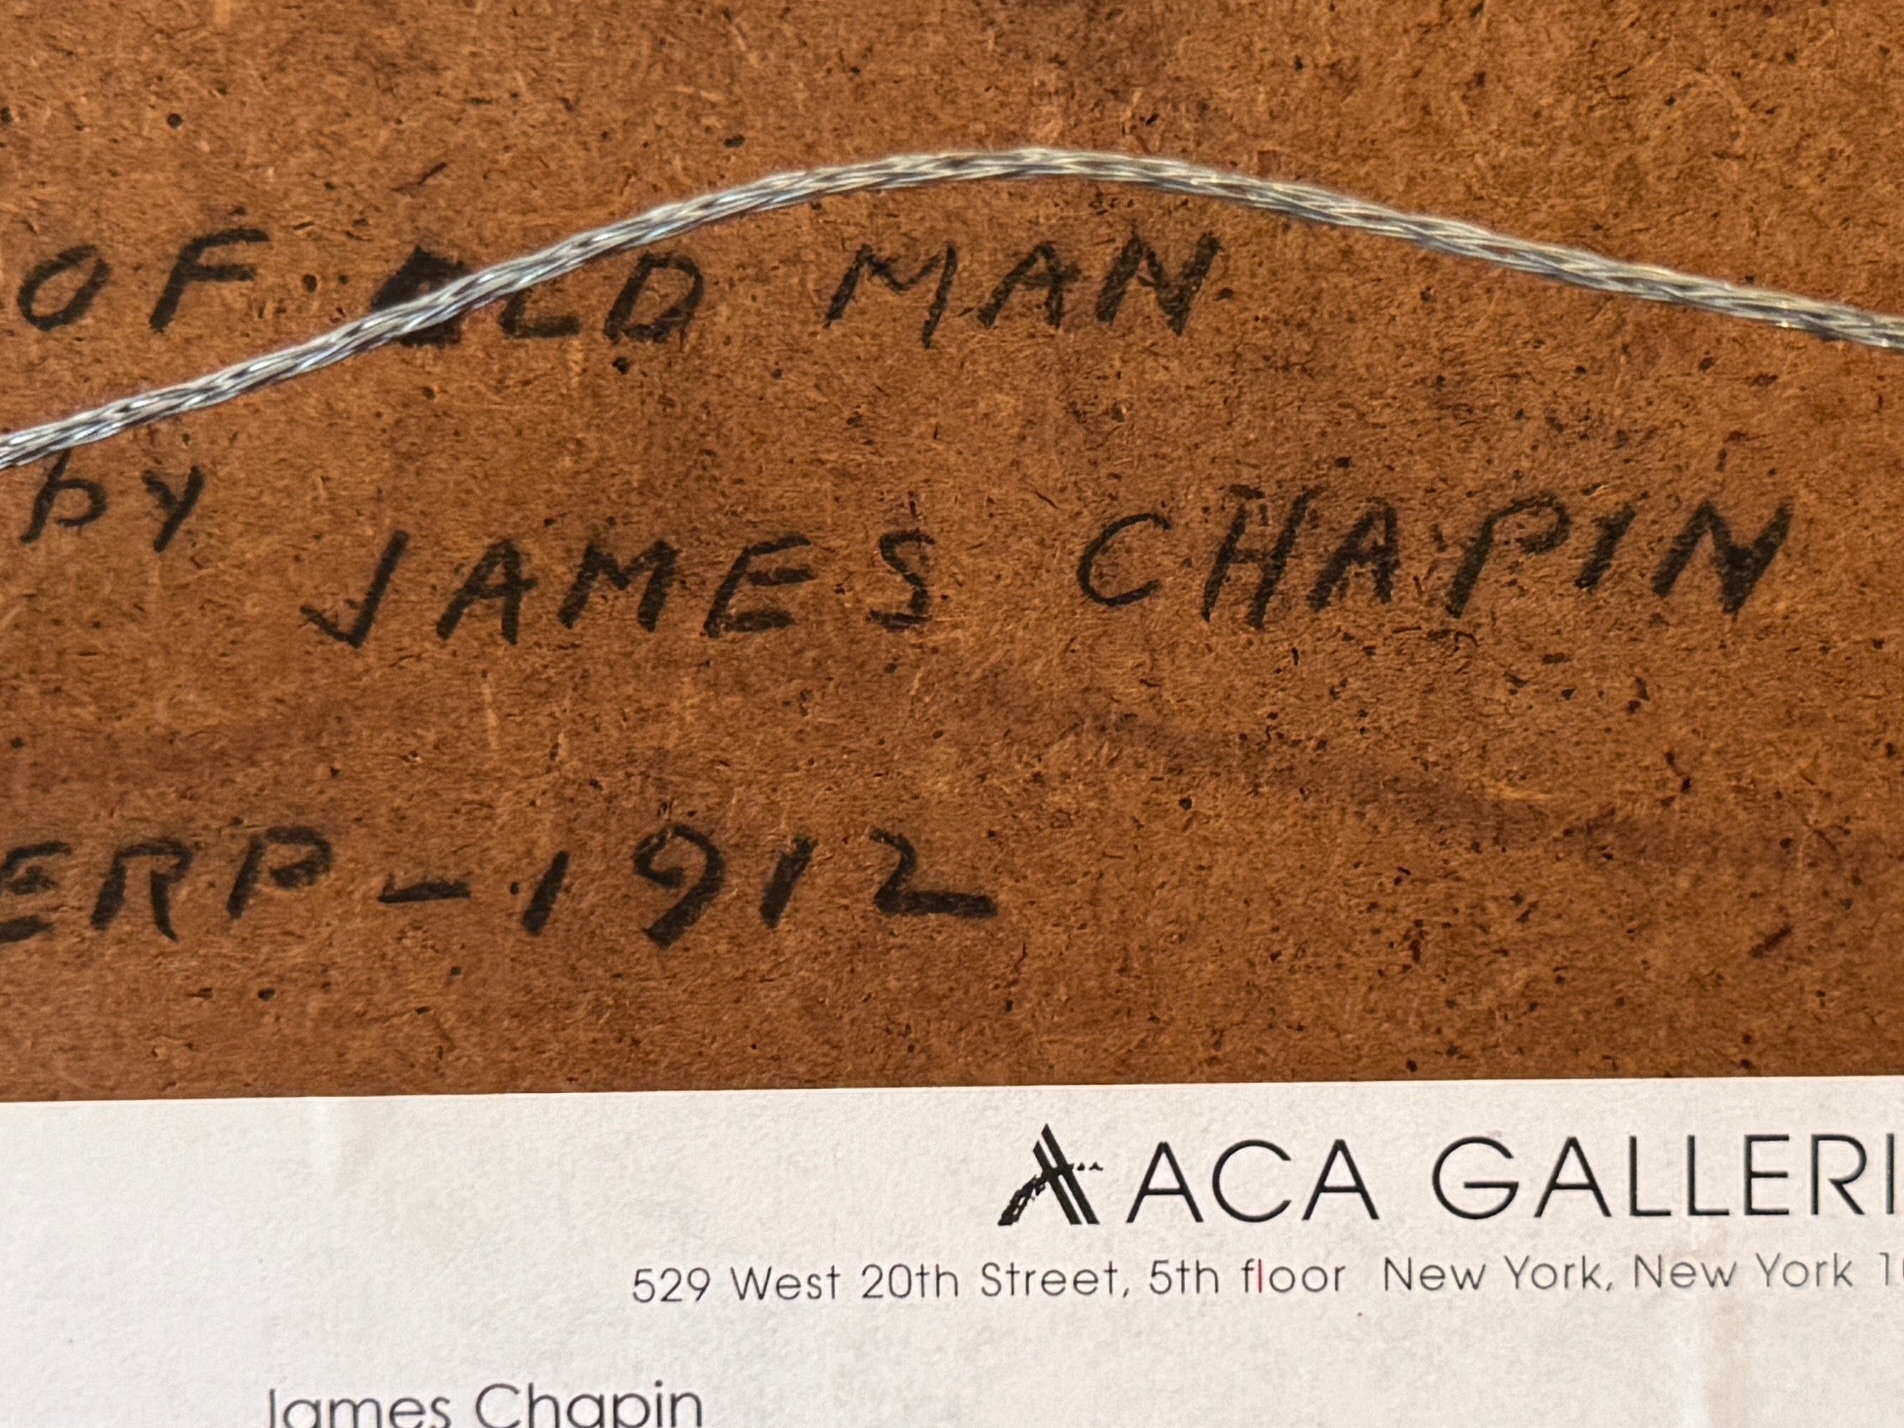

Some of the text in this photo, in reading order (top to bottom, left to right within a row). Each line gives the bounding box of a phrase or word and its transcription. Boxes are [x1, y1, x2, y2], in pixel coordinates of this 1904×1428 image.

[16, 227, 272, 334] OF
[823, 228, 1224, 349] MAN
[301, 529, 938, 650] JAMES
[1076, 484, 1793, 630] CHAPIN
[1124, 1137, 1381, 1225] ACA
[631, 1266, 712, 1305] 529
[729, 1264, 842, 1302] West
[860, 1262, 960, 1300] 20th
[980, 1259, 1130, 1299] Street,
[1148, 1258, 1220, 1297] 5th
[1240, 1257, 1347, 1295] floor
[1383, 1256, 1487, 1293] New
[1503, 1254, 1614, 1293] York,
[1633, 1253, 1738, 1290] New
[1754, 1251, 1854, 1289] York
